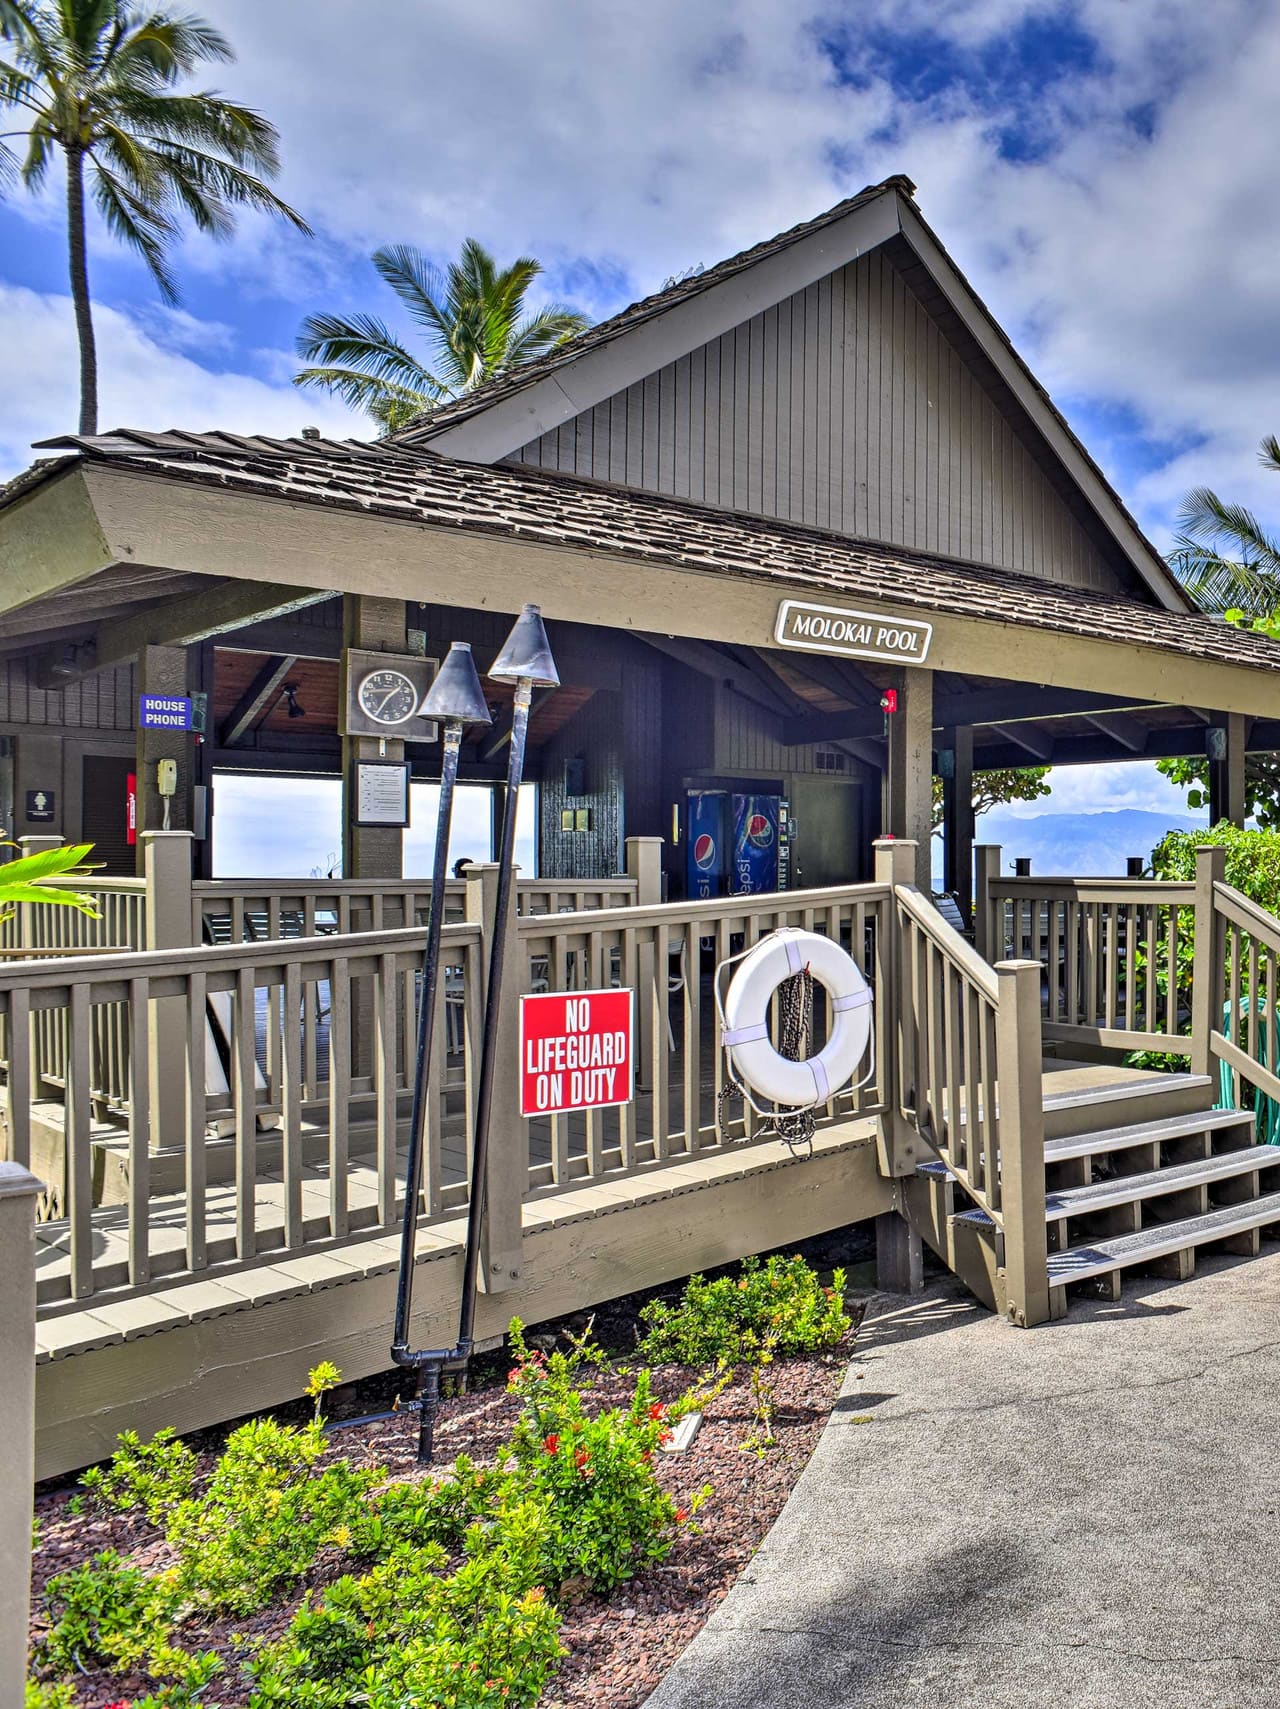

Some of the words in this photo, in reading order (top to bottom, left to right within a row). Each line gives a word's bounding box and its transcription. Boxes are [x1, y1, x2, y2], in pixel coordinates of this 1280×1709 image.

[792, 614, 872, 644] MOLOKAI
[875, 627, 918, 651] POOL
[145, 699, 186, 712] HOUSE
[145, 713, 186, 726] PHONE
[738, 859, 754, 896] epsi
[565, 998, 590, 1033] NO
[527, 1031, 626, 1074] LIFEGUARD
[536, 1073, 562, 1109] ON
[570, 1067, 617, 1105] DUTY
